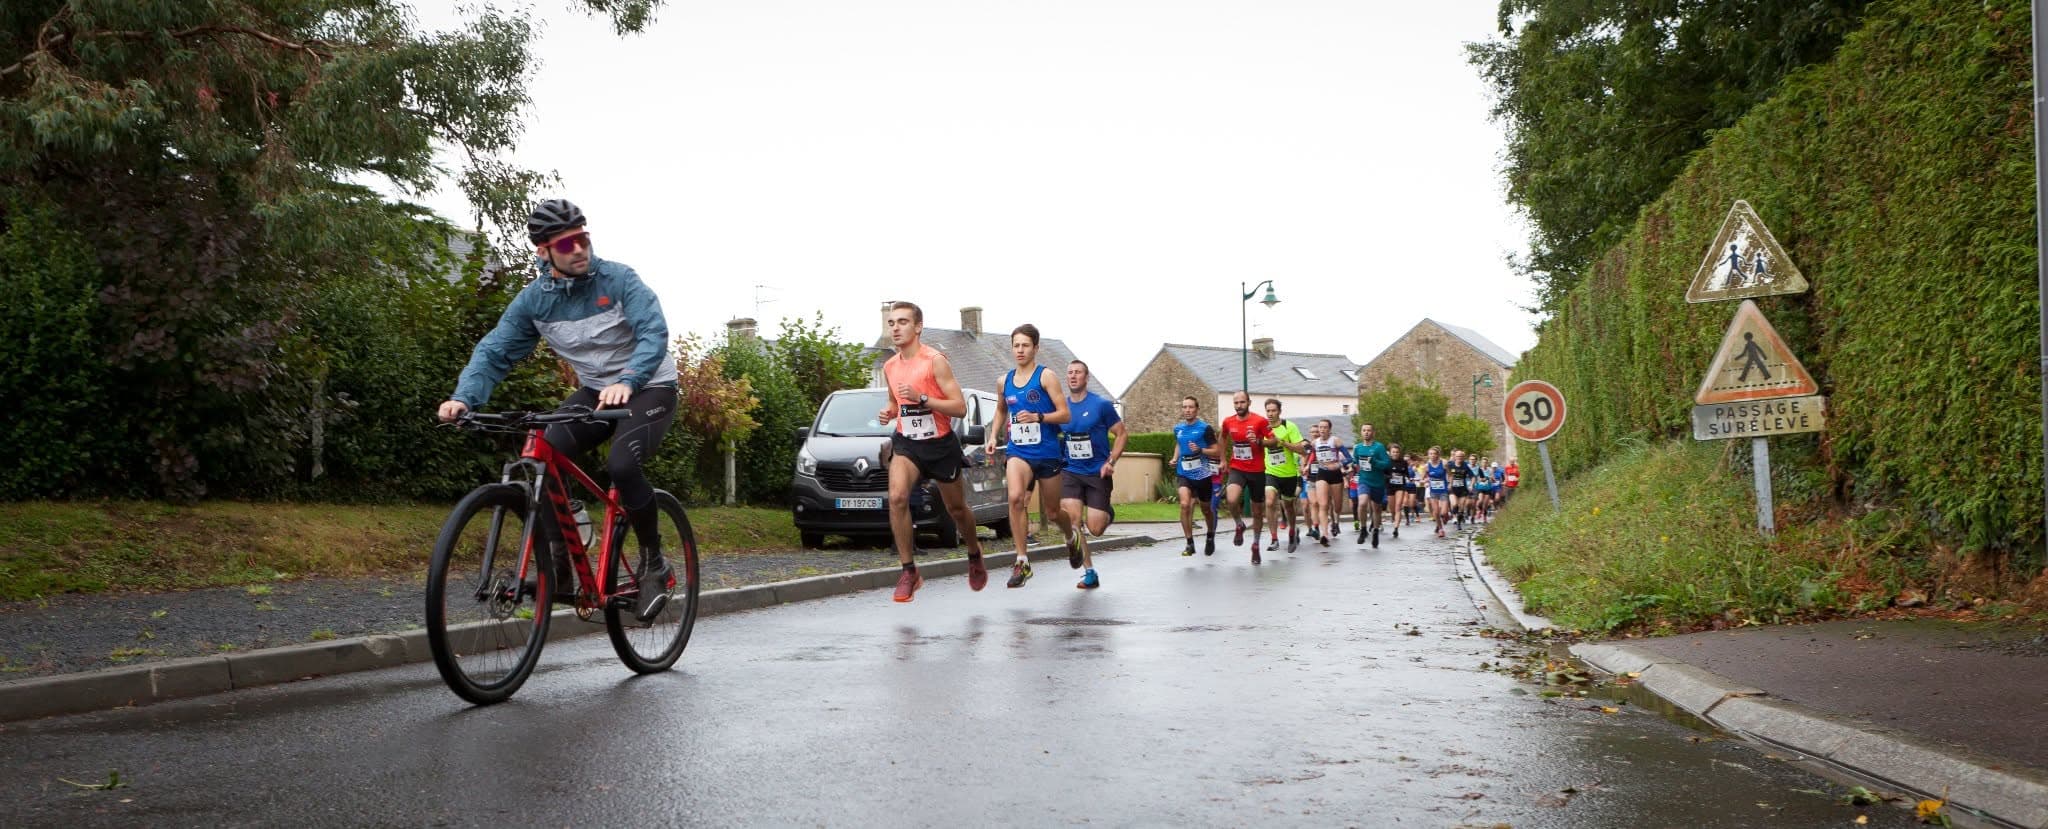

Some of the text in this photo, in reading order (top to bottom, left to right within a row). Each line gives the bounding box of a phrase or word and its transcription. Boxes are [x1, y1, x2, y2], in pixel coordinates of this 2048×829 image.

[1515, 397, 1553, 426] 30
[1715, 401, 1800, 420] PASSAGE
[911, 418, 922, 428] 67
[1020, 425, 1030, 434] 14
[1709, 413, 1809, 435] SURÉLEVÉ
